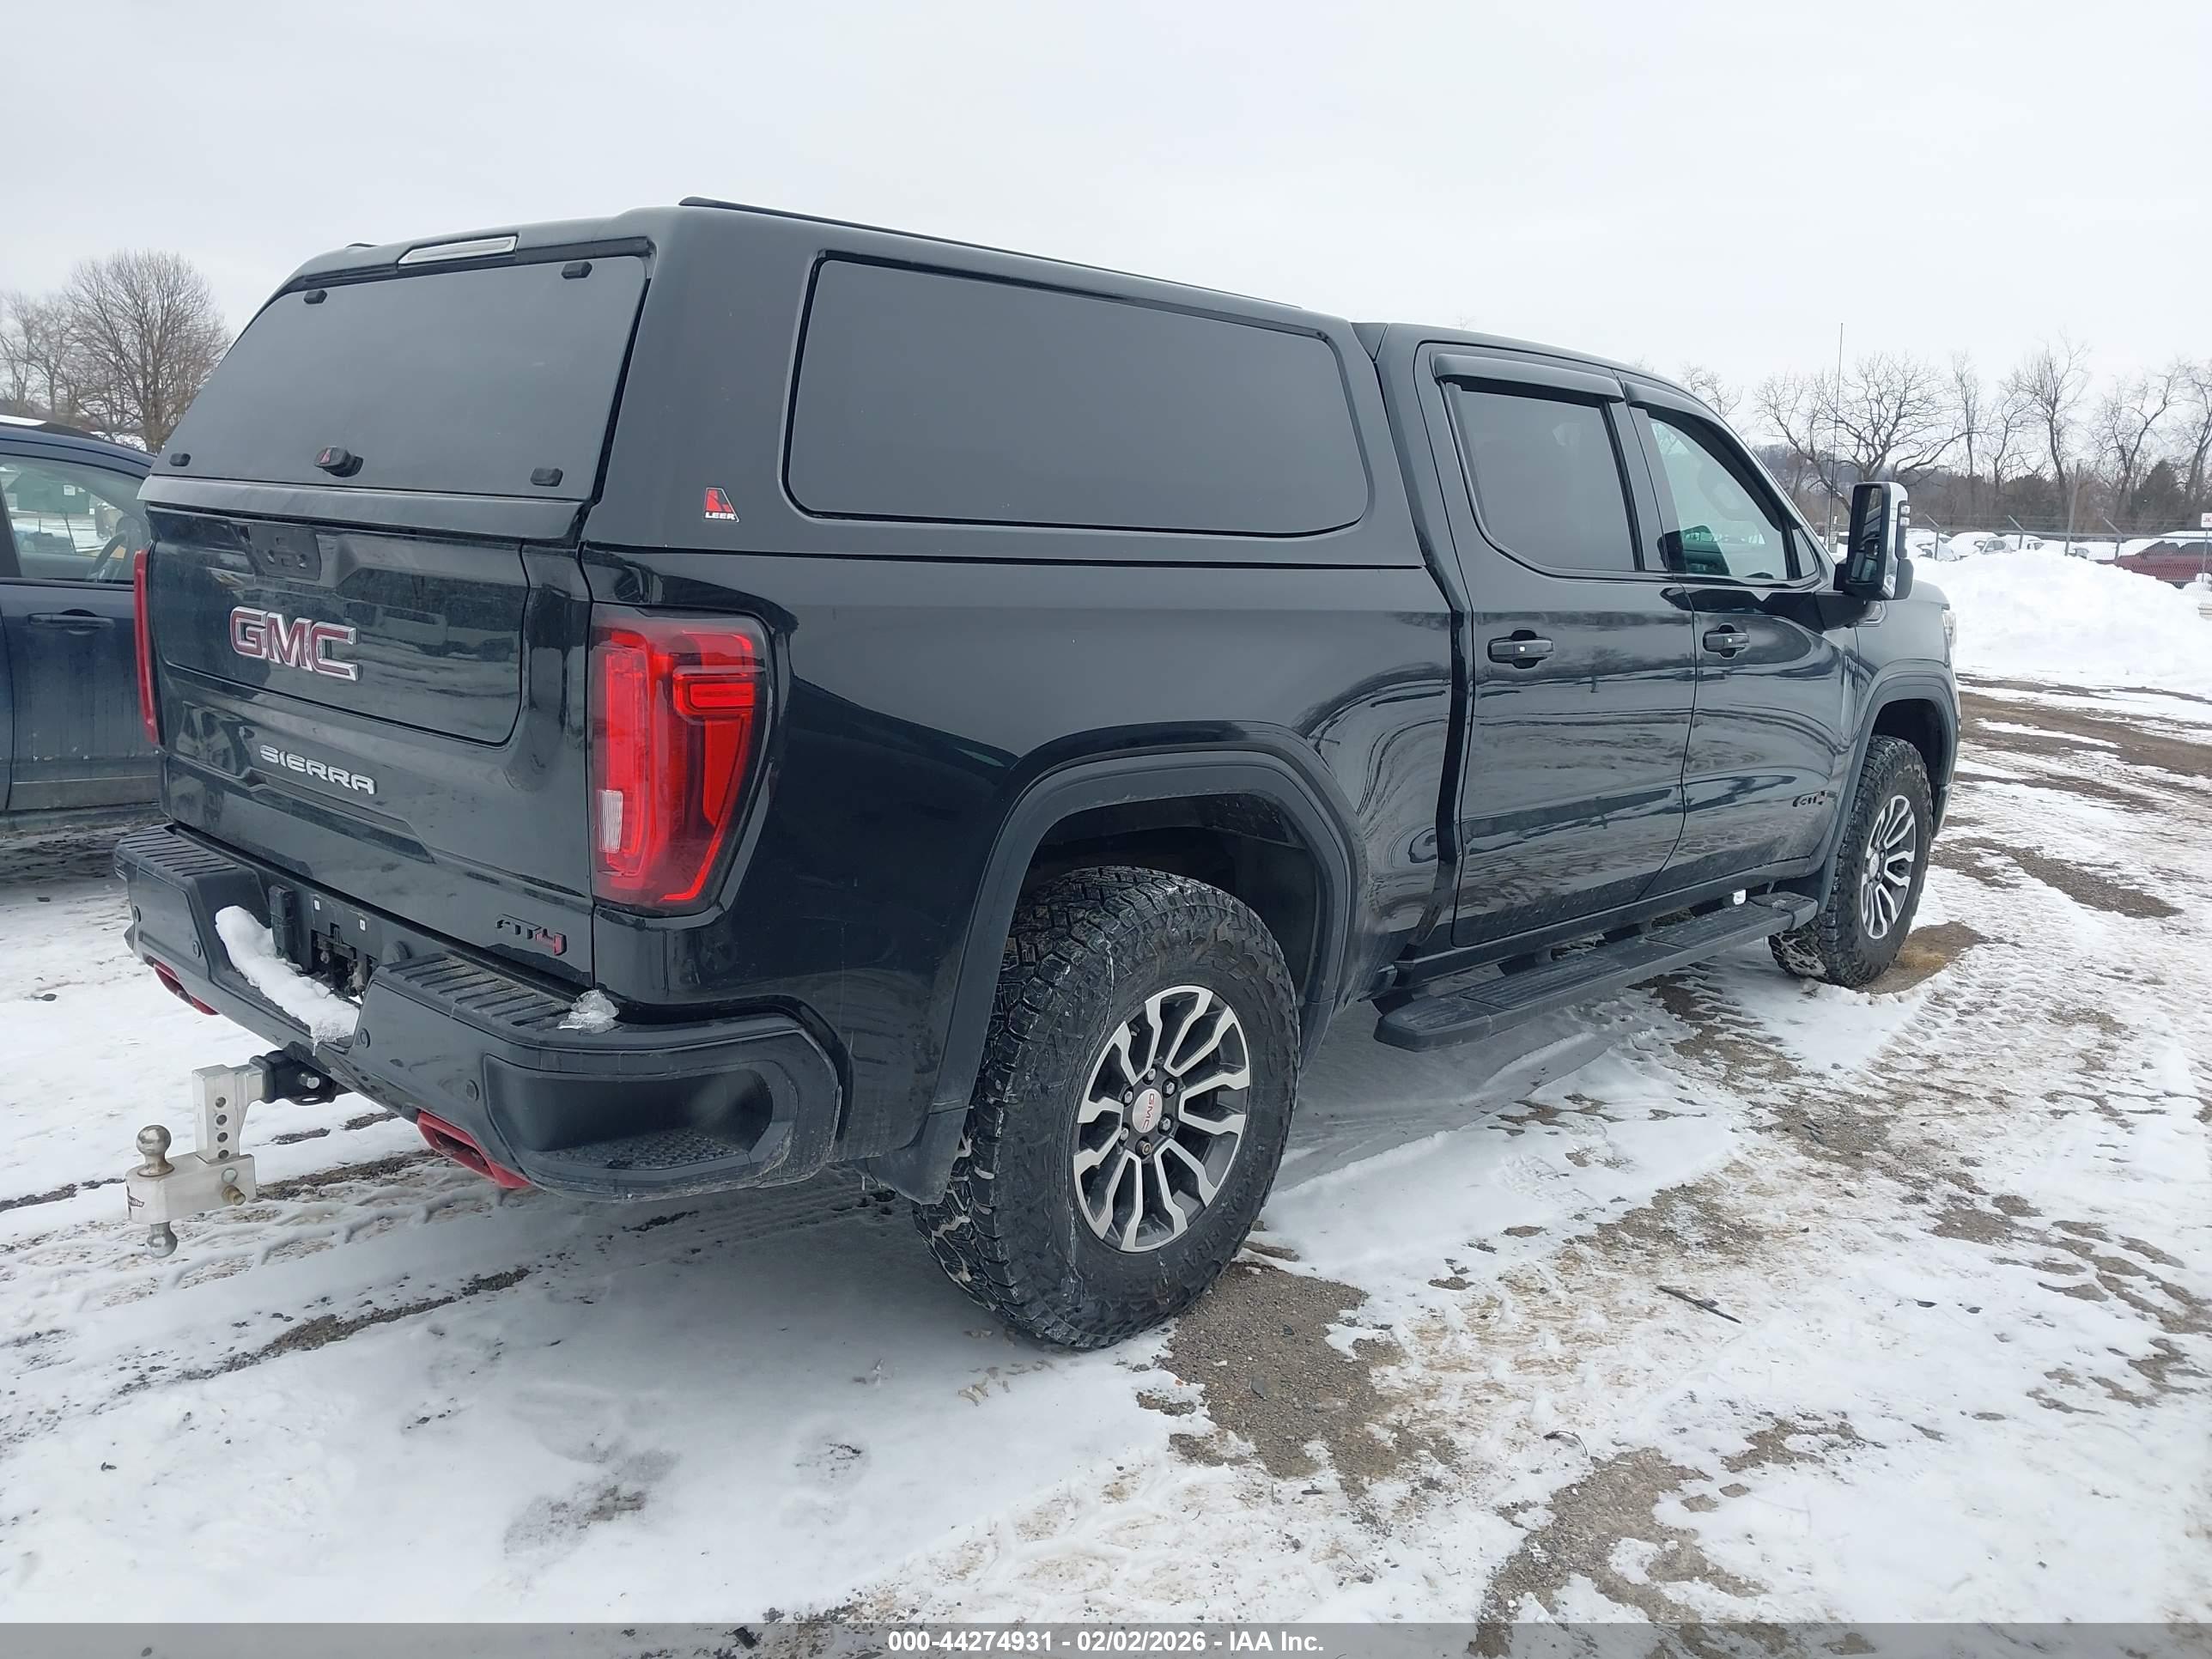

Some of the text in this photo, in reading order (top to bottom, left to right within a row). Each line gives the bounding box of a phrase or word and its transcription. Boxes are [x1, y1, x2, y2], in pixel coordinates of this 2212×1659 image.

[704, 512, 736, 520] LEER
[229, 605, 360, 682] GMC
[259, 744, 376, 795] SIERRA
[1142, 1092, 1155, 1130] GMC
